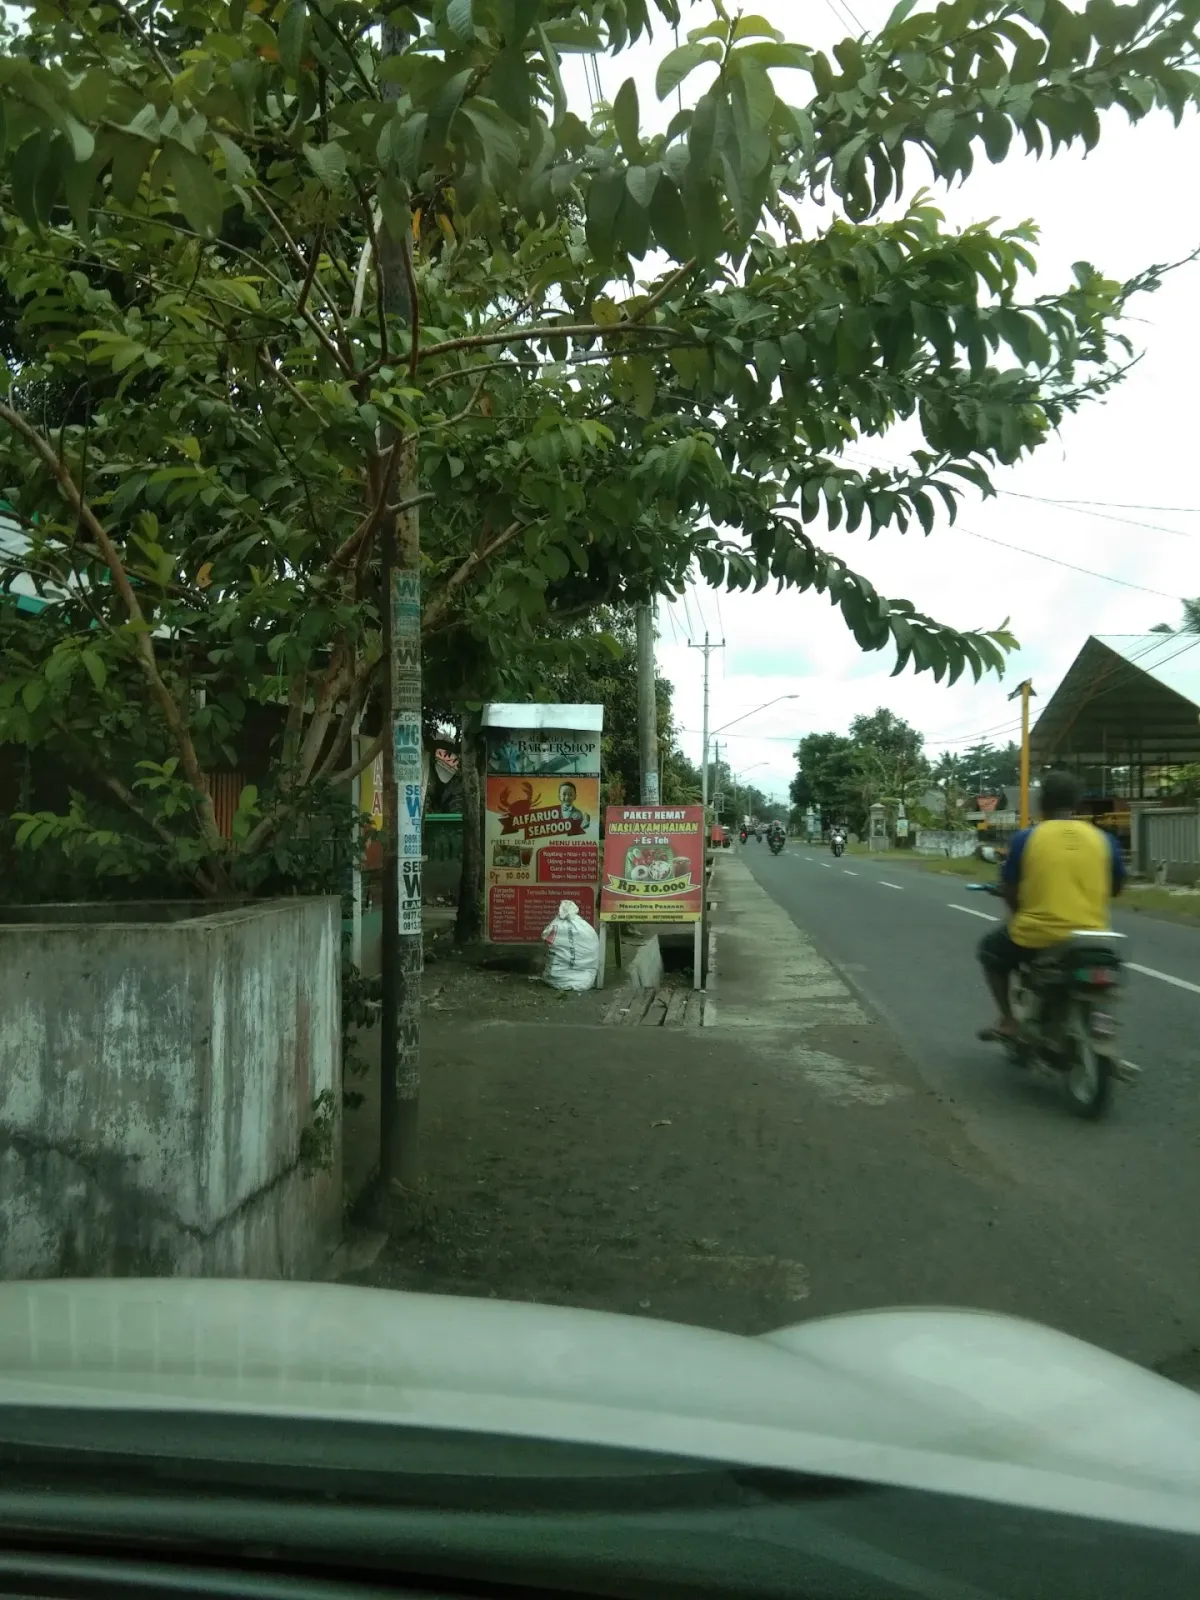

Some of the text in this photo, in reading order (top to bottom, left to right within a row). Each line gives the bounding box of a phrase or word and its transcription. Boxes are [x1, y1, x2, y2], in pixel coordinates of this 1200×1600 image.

[518, 740, 596, 756] BARERSHOP
[512, 809, 559, 826] ALFARUQ
[624, 811, 686, 819] PAKET HEMAT
[528, 821, 572, 837] SEAFOOD
[654, 836, 669, 844] Teh
[643, 881, 686, 893] 10.000
